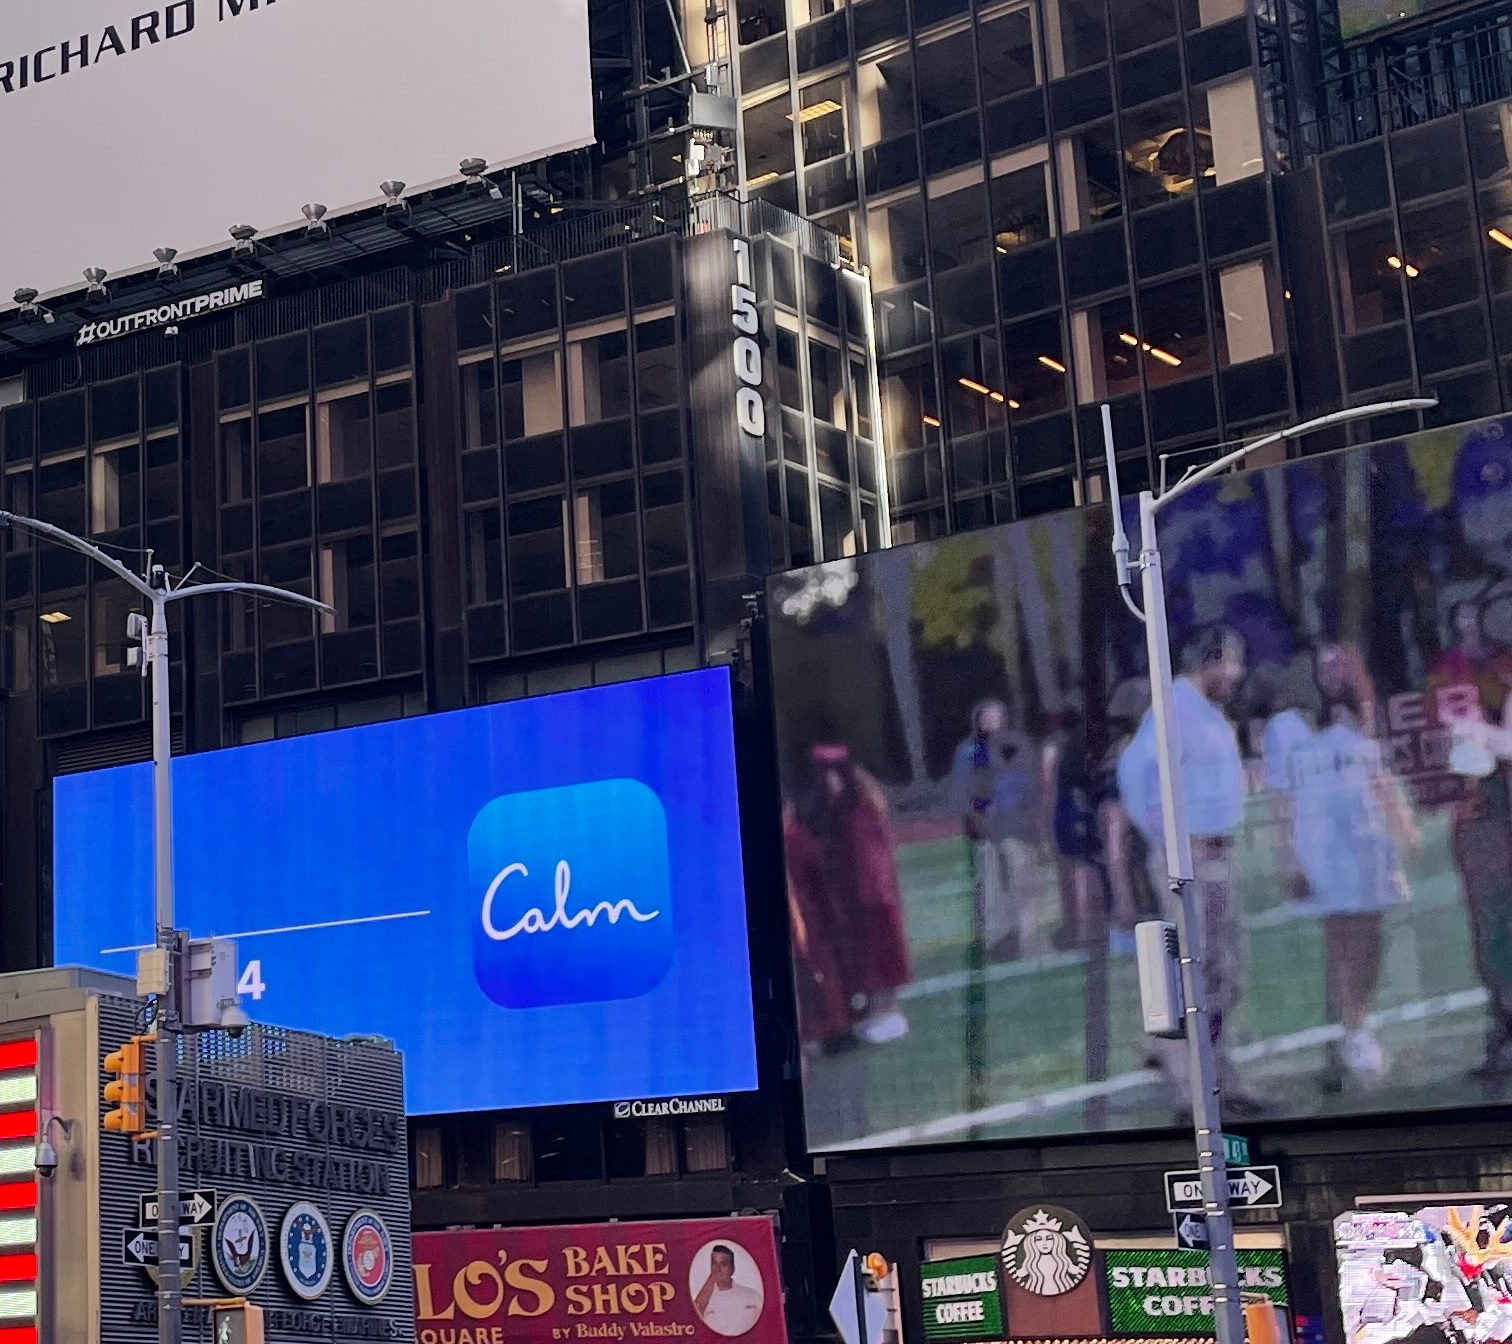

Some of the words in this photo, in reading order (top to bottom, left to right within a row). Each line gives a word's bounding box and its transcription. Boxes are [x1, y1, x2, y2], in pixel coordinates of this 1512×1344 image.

[732, 238, 765, 437] 1500
[482, 859, 660, 941] Calm
[133, 1136, 288, 1181] RRUITING
[1228, 1180, 1261, 1196] WAY
[182, 1201, 205, 1215] WAY
[134, 1240, 157, 1254] ONE
[562, 1242, 670, 1277] BAKE
[922, 1271, 998, 1298] STARBUCKS
[1112, 1267, 1284, 1288] STARBKS
[565, 1281, 676, 1316] SHOP
[1143, 1295, 1216, 1317] COFF
[936, 1300, 985, 1324] COFFEE
[552, 1328, 571, 1340] BY
[576, 1323, 627, 1341] Buddy
[630, 1322, 695, 1338] Valastro
